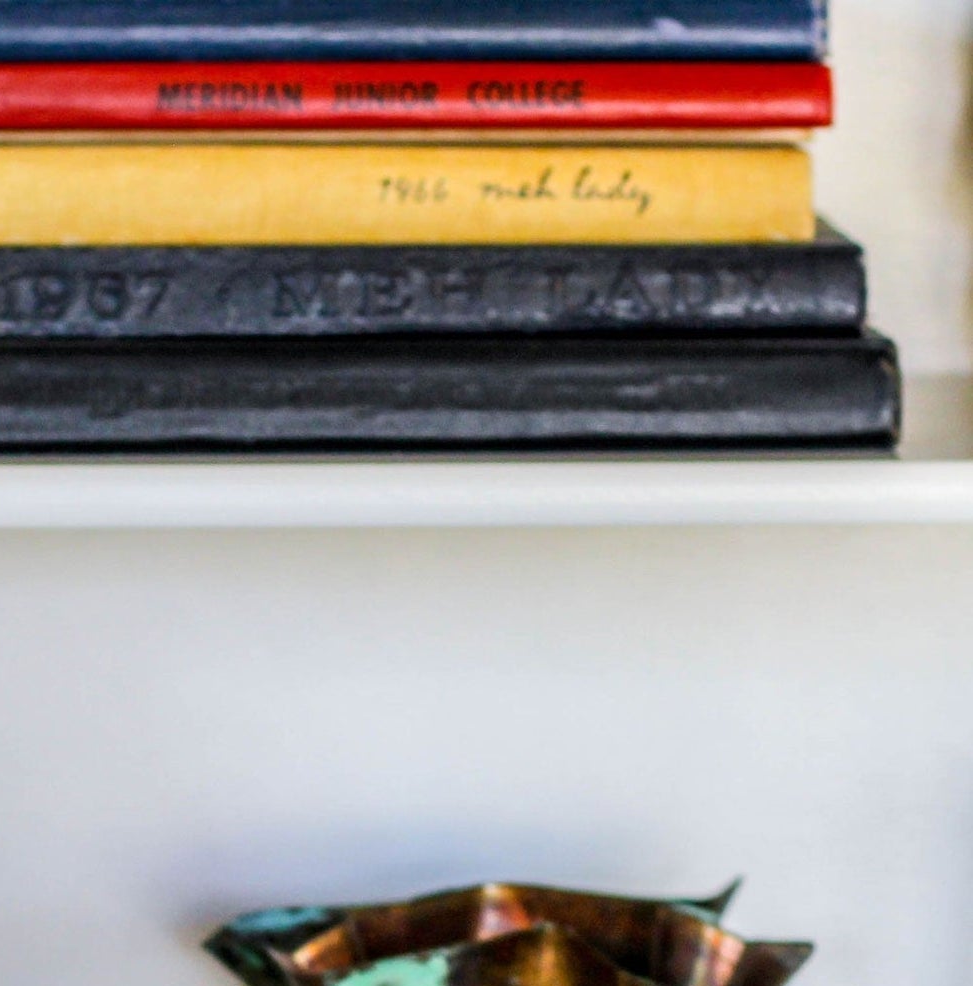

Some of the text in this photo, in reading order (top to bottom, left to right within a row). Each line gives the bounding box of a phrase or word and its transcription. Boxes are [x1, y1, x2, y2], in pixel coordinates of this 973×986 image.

[155, 77, 588, 113] MERIDIAN JUNIOR COLLEGE
